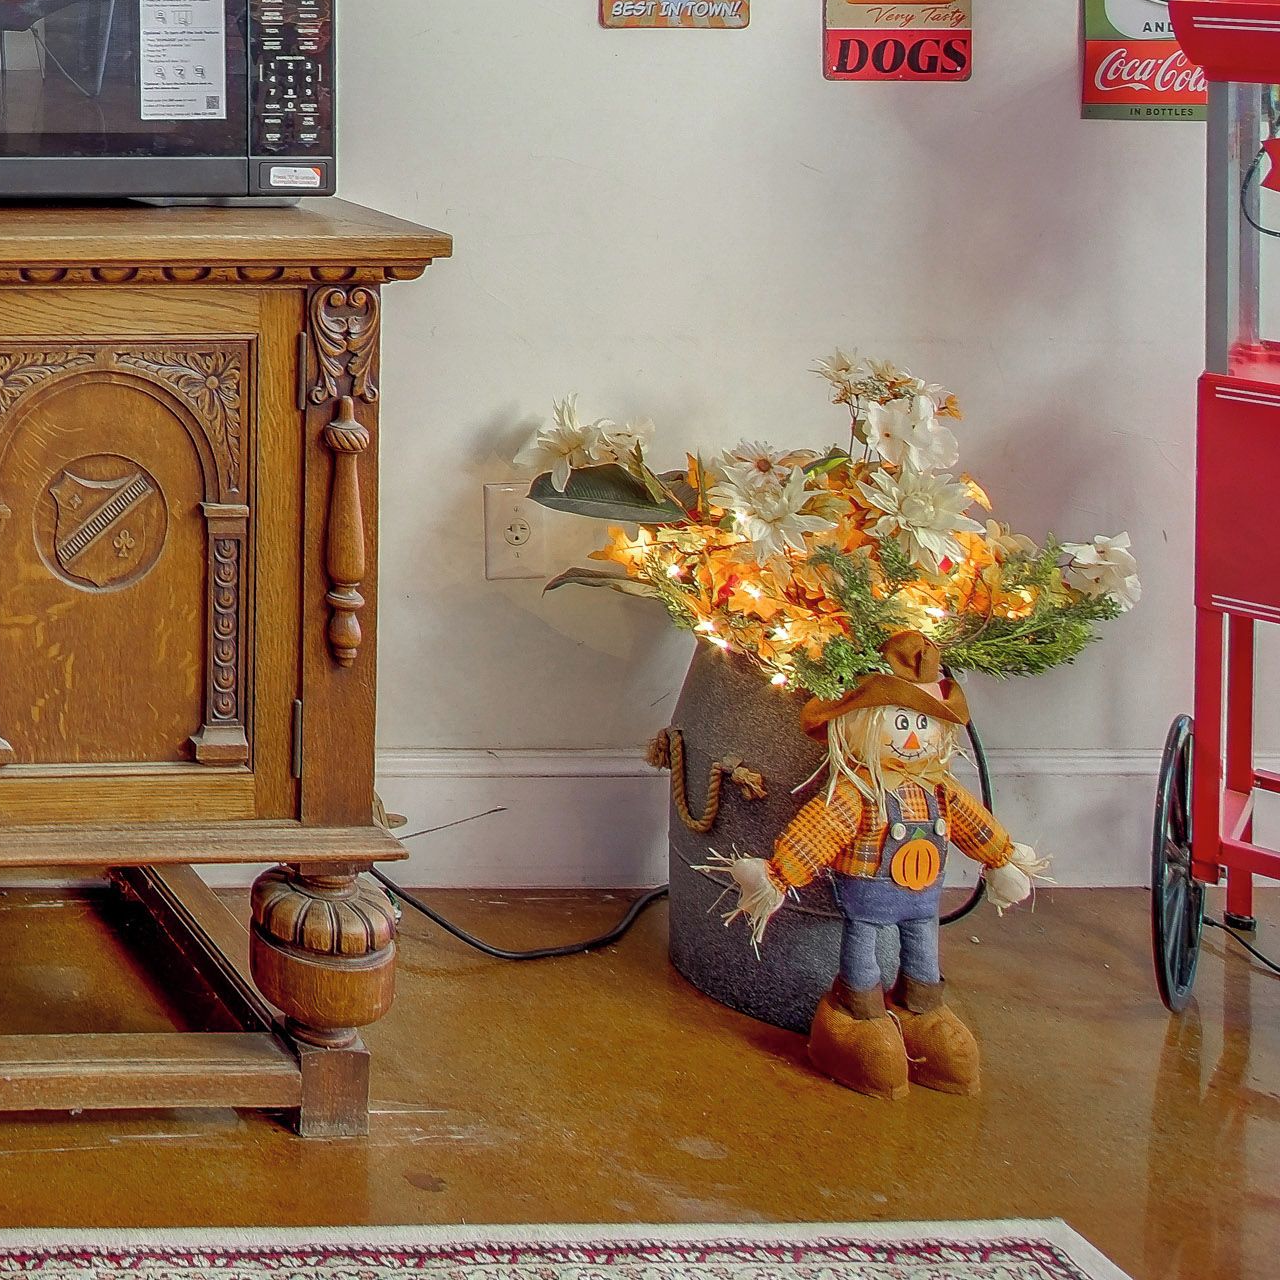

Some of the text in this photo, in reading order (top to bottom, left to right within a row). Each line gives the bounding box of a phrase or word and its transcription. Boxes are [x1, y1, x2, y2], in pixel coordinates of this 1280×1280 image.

[611, 0, 743, 18] BEST IN TOWN!
[866, 5, 968, 28] Very Tasty
[834, 38, 967, 74] DOGS
[287, 62, 294, 70] 2
[305, 62, 312, 70] 3
[1130, 108, 1194, 116] IN BOTTLES
